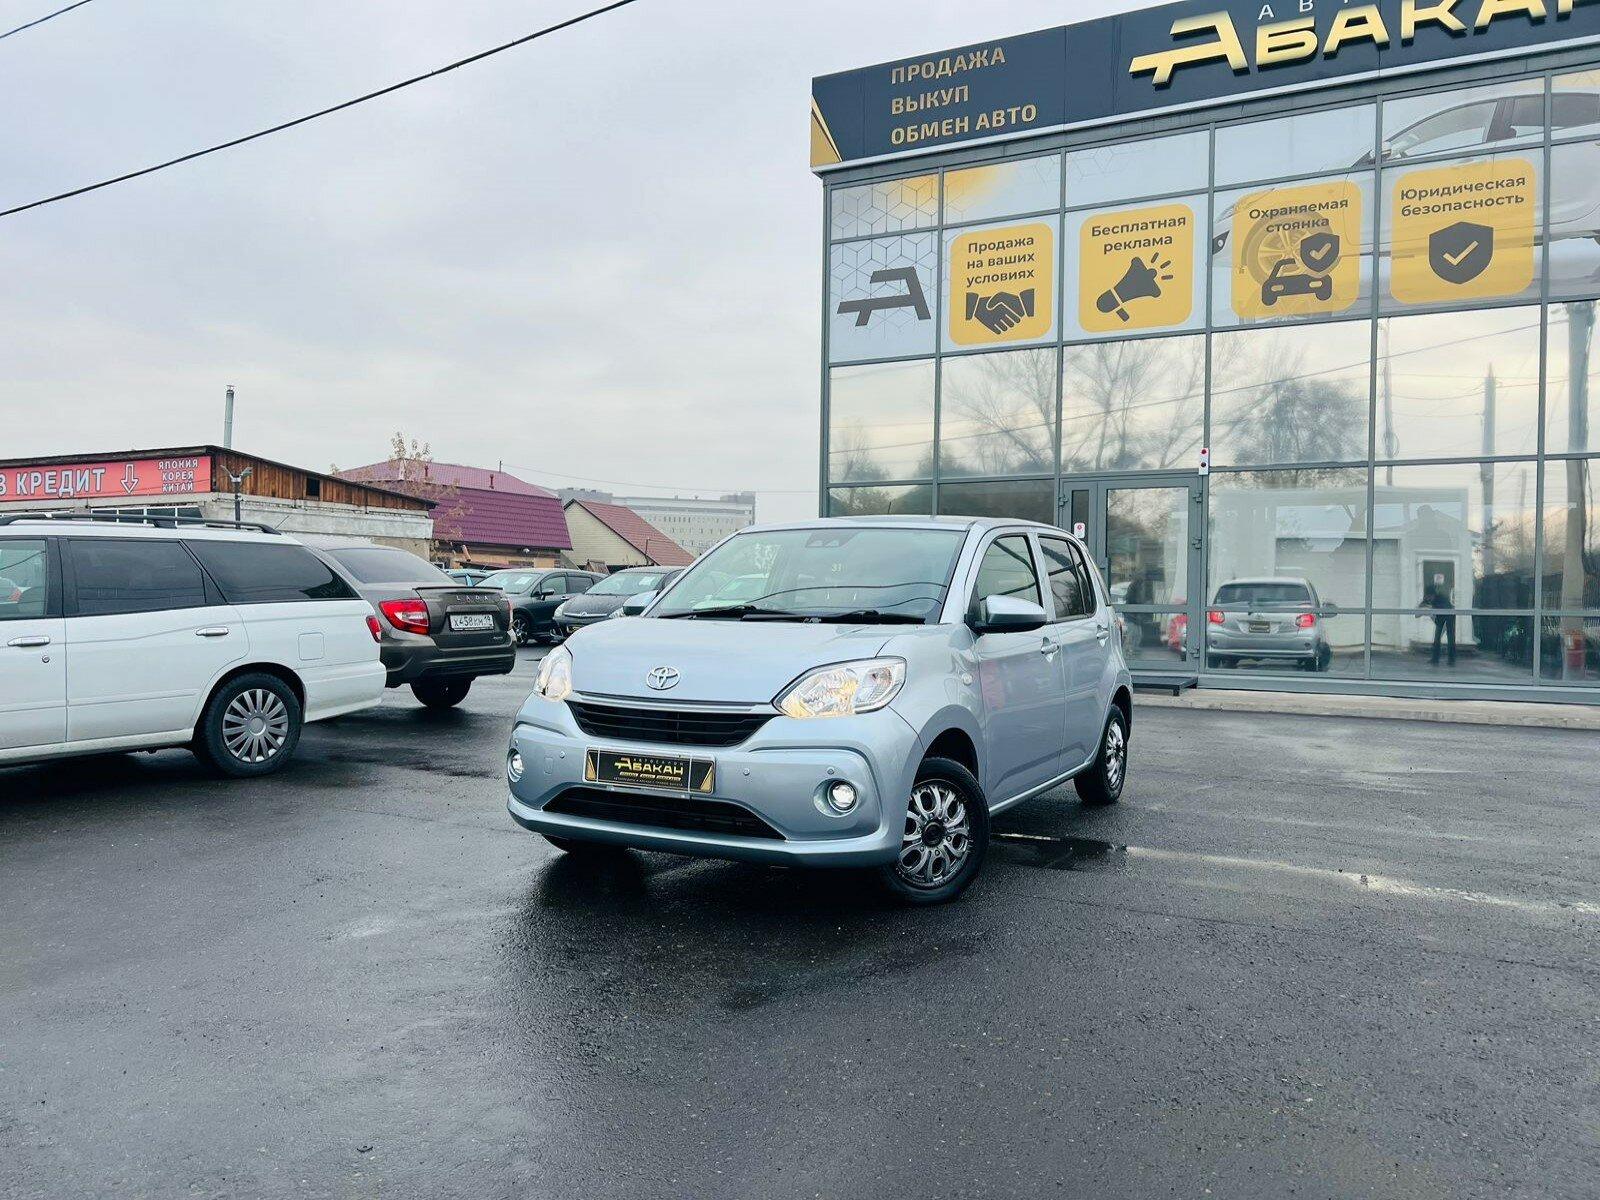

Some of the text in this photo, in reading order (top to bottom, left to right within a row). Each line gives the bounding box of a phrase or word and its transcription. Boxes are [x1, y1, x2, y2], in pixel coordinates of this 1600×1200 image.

[1128, 0, 1578, 85] АБАКА
[891, 47, 1006, 85] ПРОДАЖА
[891, 84, 969, 115] ВЫКУП
[891, 104, 1037, 146] ОБМЕН АВТО
[1401, 175, 1526, 202] Юридическая
[1249, 198, 1349, 220] Охраняемая
[1401, 193, 1526, 218] безопасность
[1091, 215, 1187, 237] Бесплатная
[1266, 216, 1330, 233] стоянка
[968, 235, 1035, 255] Продажа
[1103, 233, 1173, 255] реклама
[967, 252, 1035, 270] на ваших
[966, 269, 1035, 288] условиях
[157, 459, 198, 470] ЯПОНИЯ
[162, 470, 194, 481] КОРЕЯ
[16, 468, 106, 497] КРЕДИТ
[162, 481, 194, 492] КИТАЙ
[614, 757, 684, 775] АБАКАН
